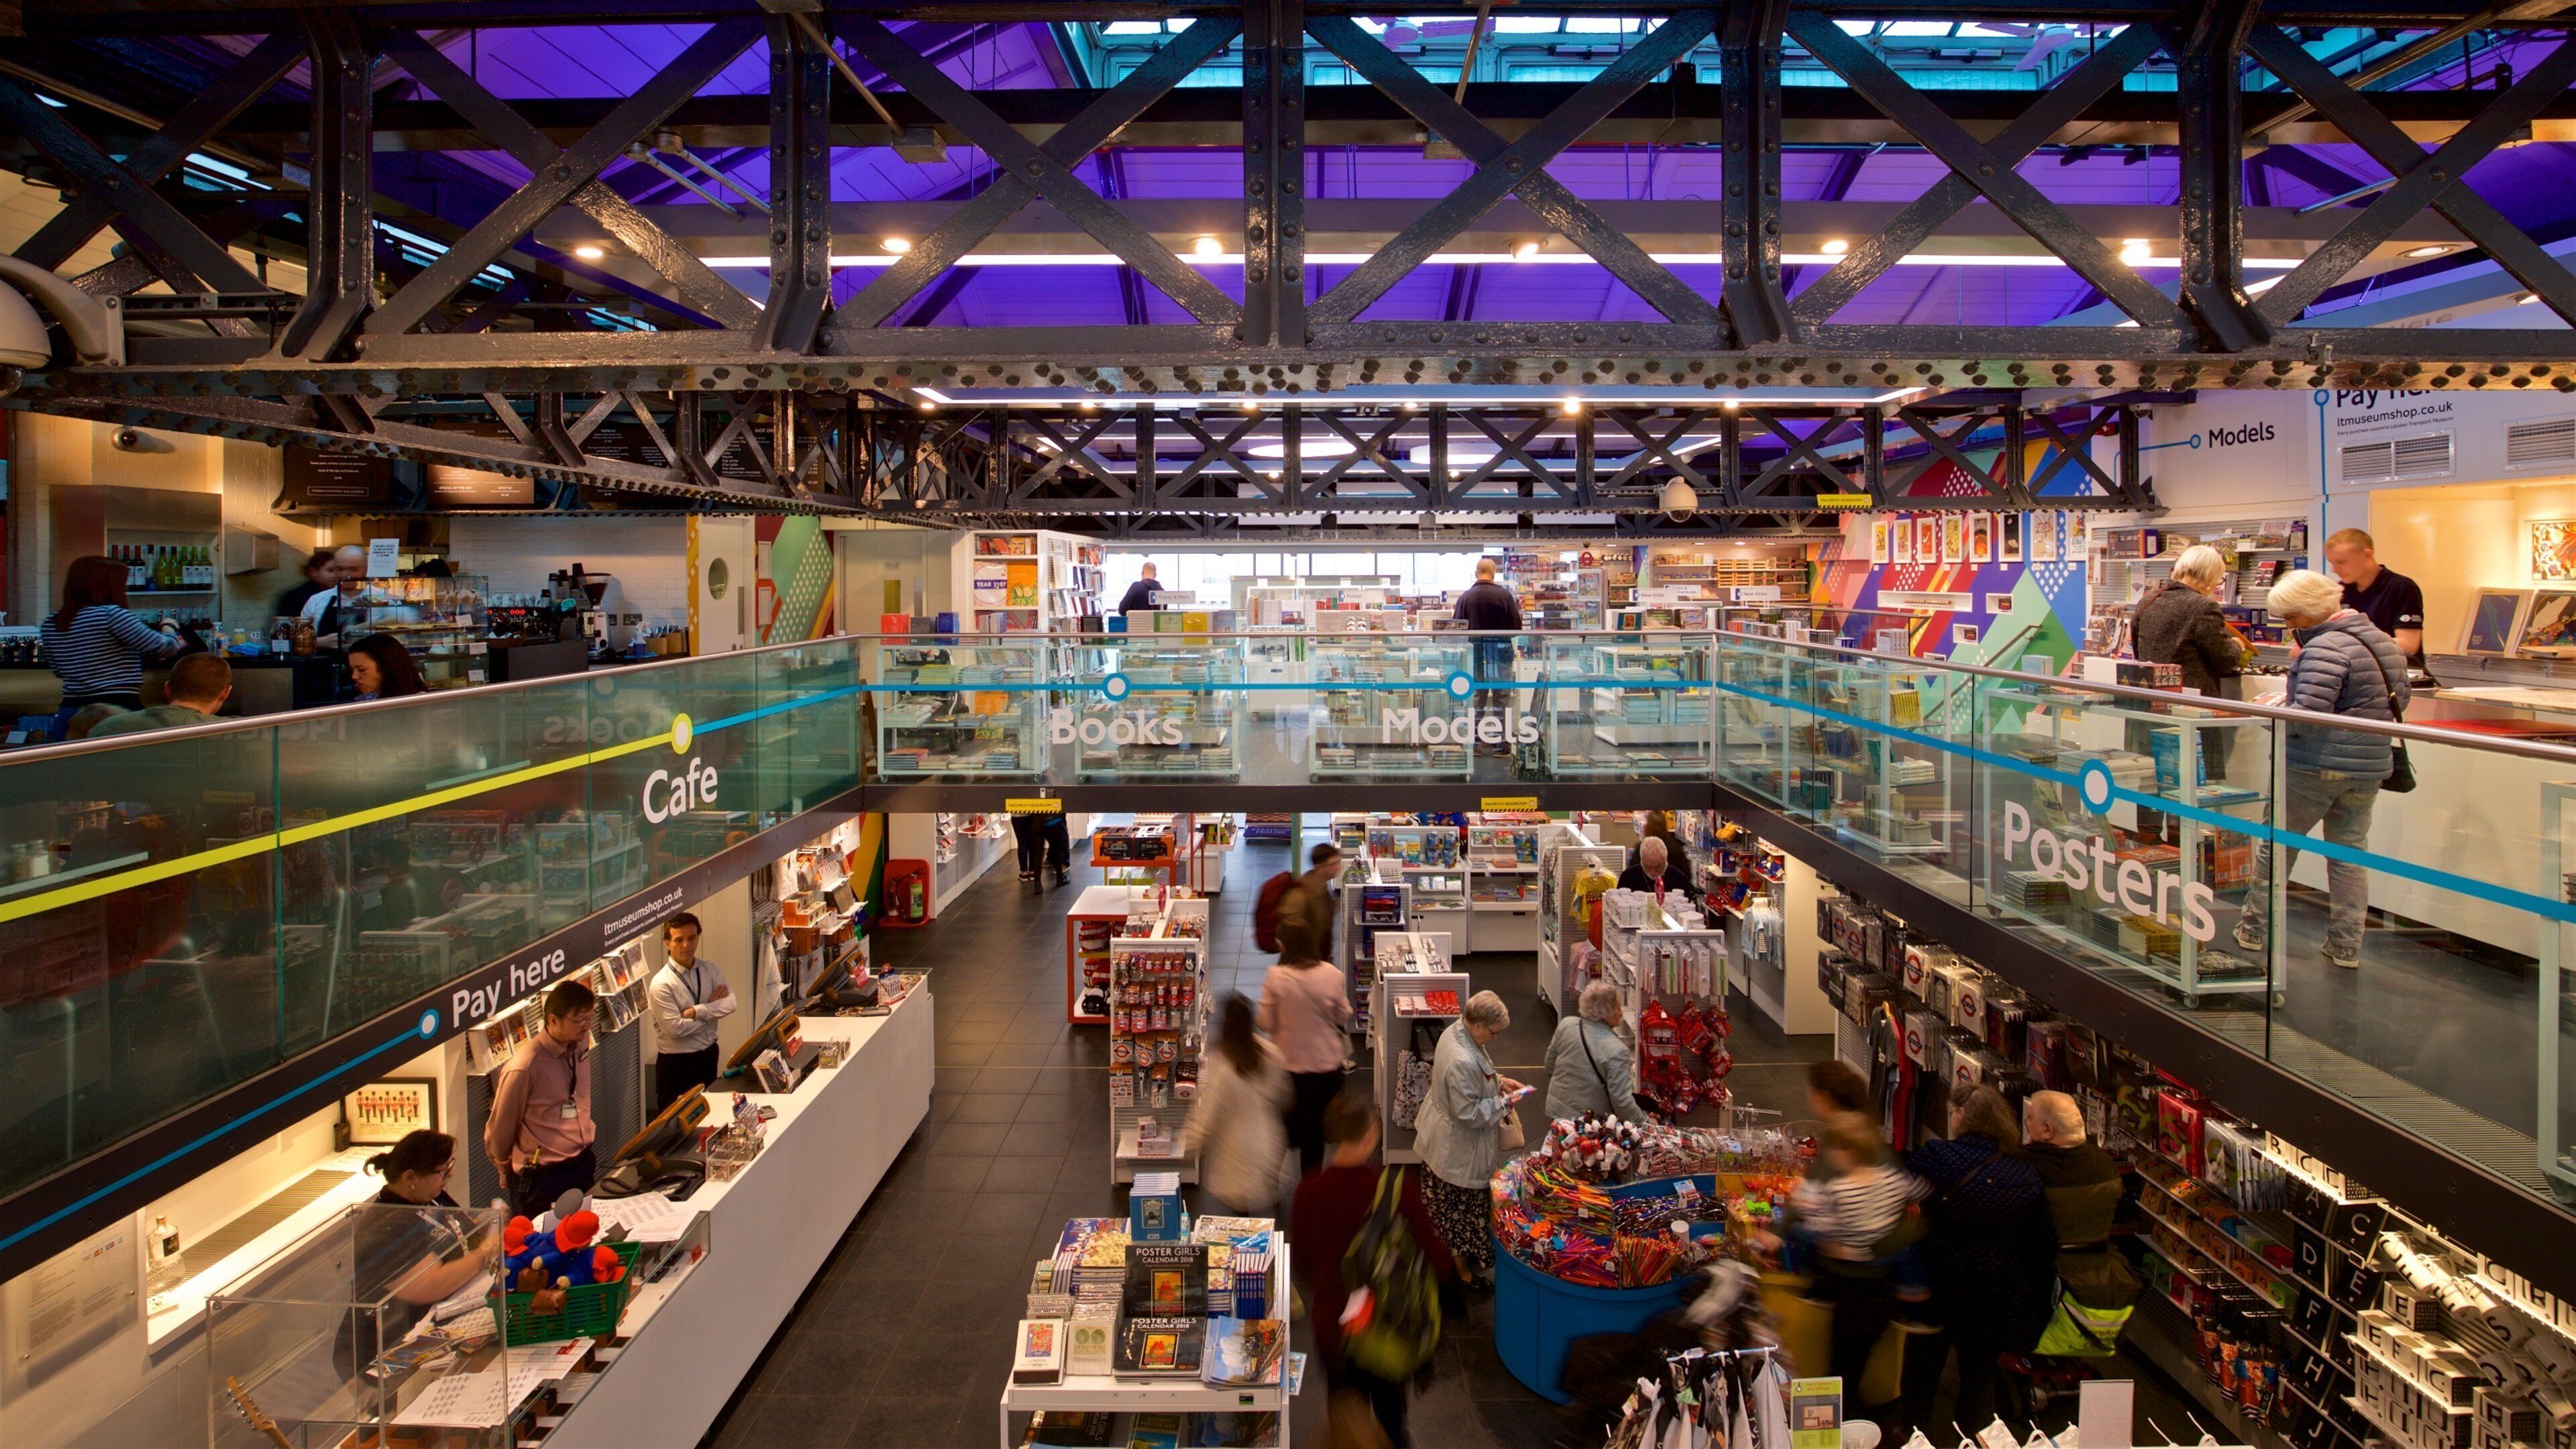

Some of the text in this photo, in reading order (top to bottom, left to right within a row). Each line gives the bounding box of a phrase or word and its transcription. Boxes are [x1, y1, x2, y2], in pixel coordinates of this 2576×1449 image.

[2337, 389, 2378, 409] Pay
[2337, 401, 2453, 427] ltmuseumshop.co.uk
[2349, 427, 2369, 435] purchase
[2369, 425, 2390, 433] supports
[2409, 419, 2432, 427] Transport
[2432, 416, 2454, 424] Museum
[2208, 421, 2275, 448] Models
[1052, 708, 1183, 745] Books
[1382, 707, 1540, 744] Models
[643, 757, 718, 824] Cafe
[2004, 800, 2216, 943] Posters
[604, 886, 683, 936] ltmuseumshop.co.uk
[604, 902, 684, 947] Every purchase supports London Transport Museum
[453, 949, 565, 1028] Pay here
[2271, 1134, 2281, 1155] B
[2306, 1189, 2320, 1208] A
[2351, 1213, 2371, 1236] C
[1136, 1247, 1200, 1256] POSTER GIRLS
[2303, 1242, 2317, 1265] D
[2350, 1270, 2367, 1295] E
[2306, 1299, 2321, 1318] F
[2396, 1295, 2408, 1318] E
[2487, 1316, 2512, 1342] S
[2304, 1356, 2324, 1382] H
[2487, 1402, 2503, 1428] R
[1095, 1421, 1106, 1441] GIRLS
[2308, 1421, 2323, 1438] J
